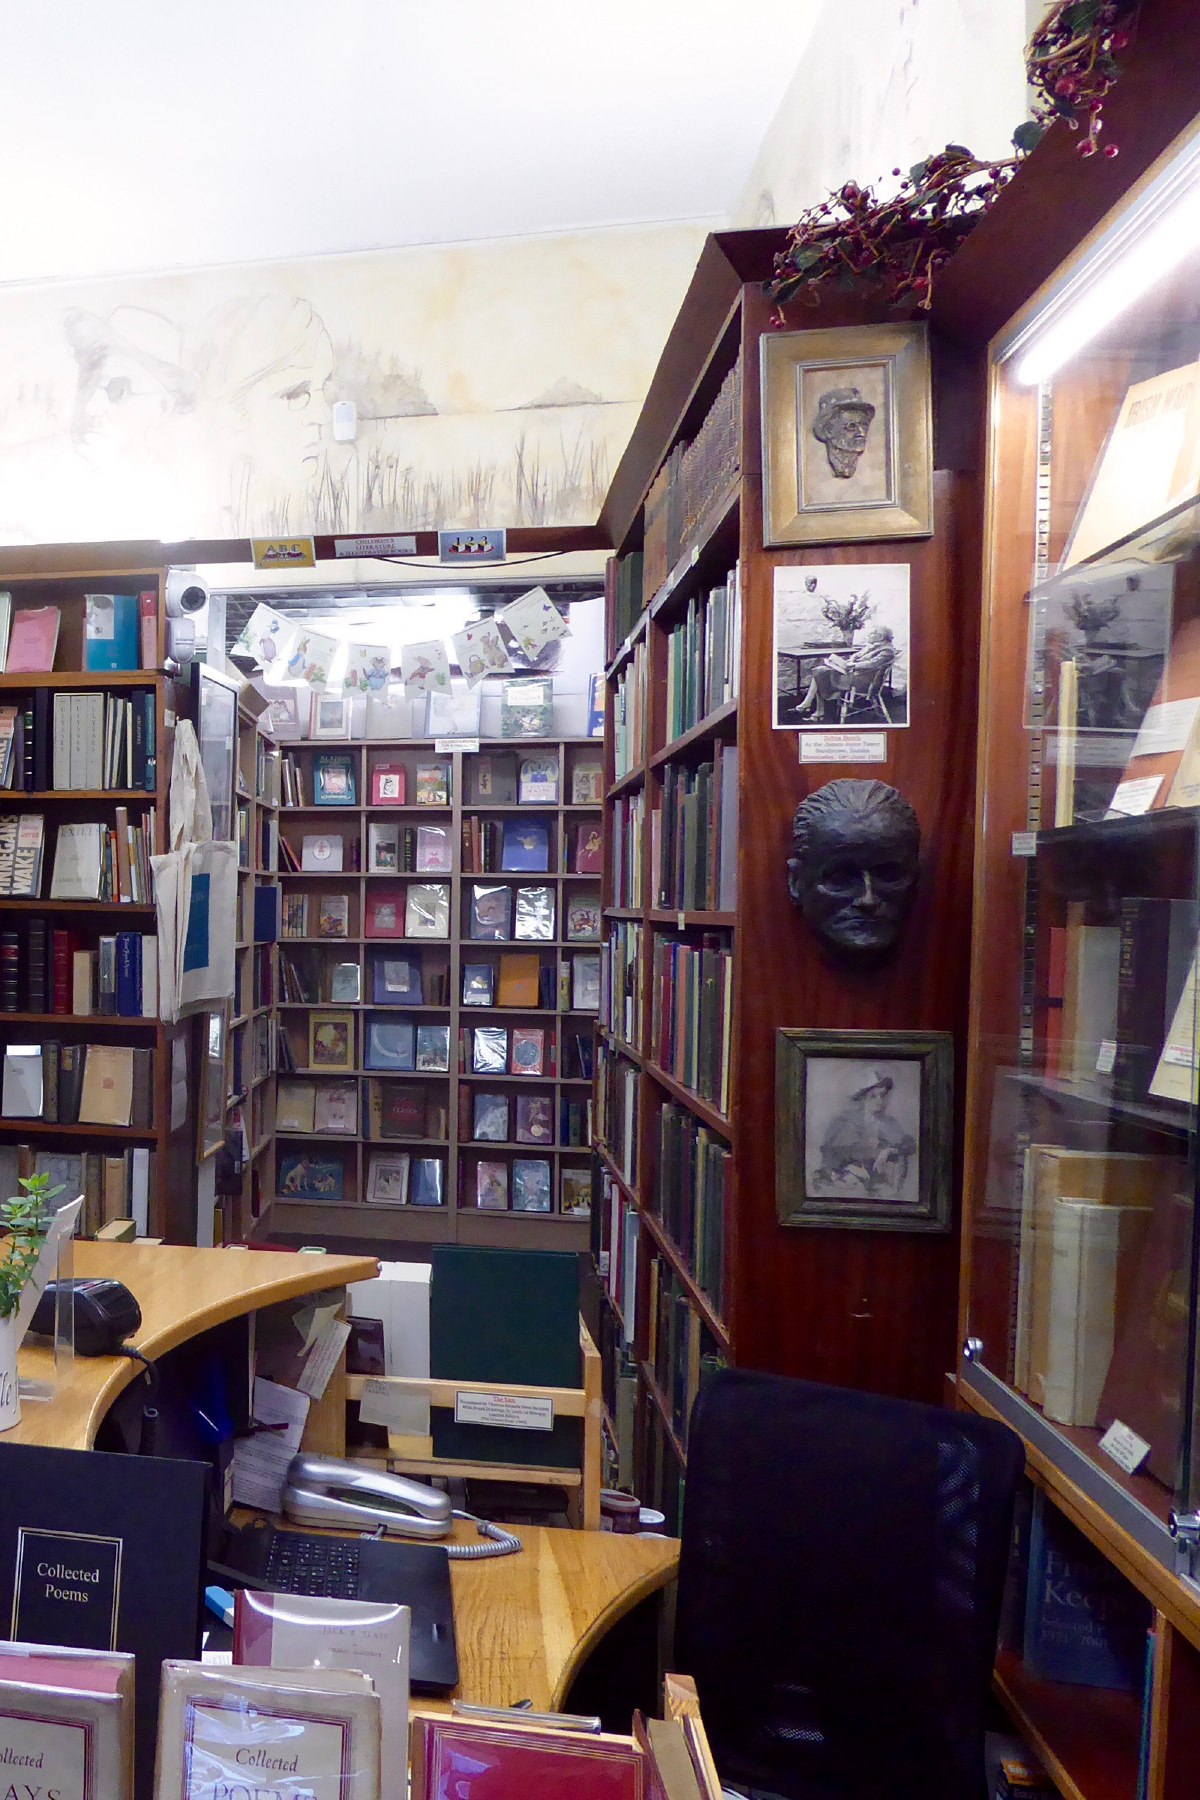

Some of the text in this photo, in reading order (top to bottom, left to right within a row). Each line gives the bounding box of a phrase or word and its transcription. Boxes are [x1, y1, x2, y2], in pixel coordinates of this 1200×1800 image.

[11, 849, 35, 896] WAKE
[37, 1561, 100, 1584] Collected
[45, 1583, 89, 1603] Poems
[235, 1747, 300, 1773] Collected
